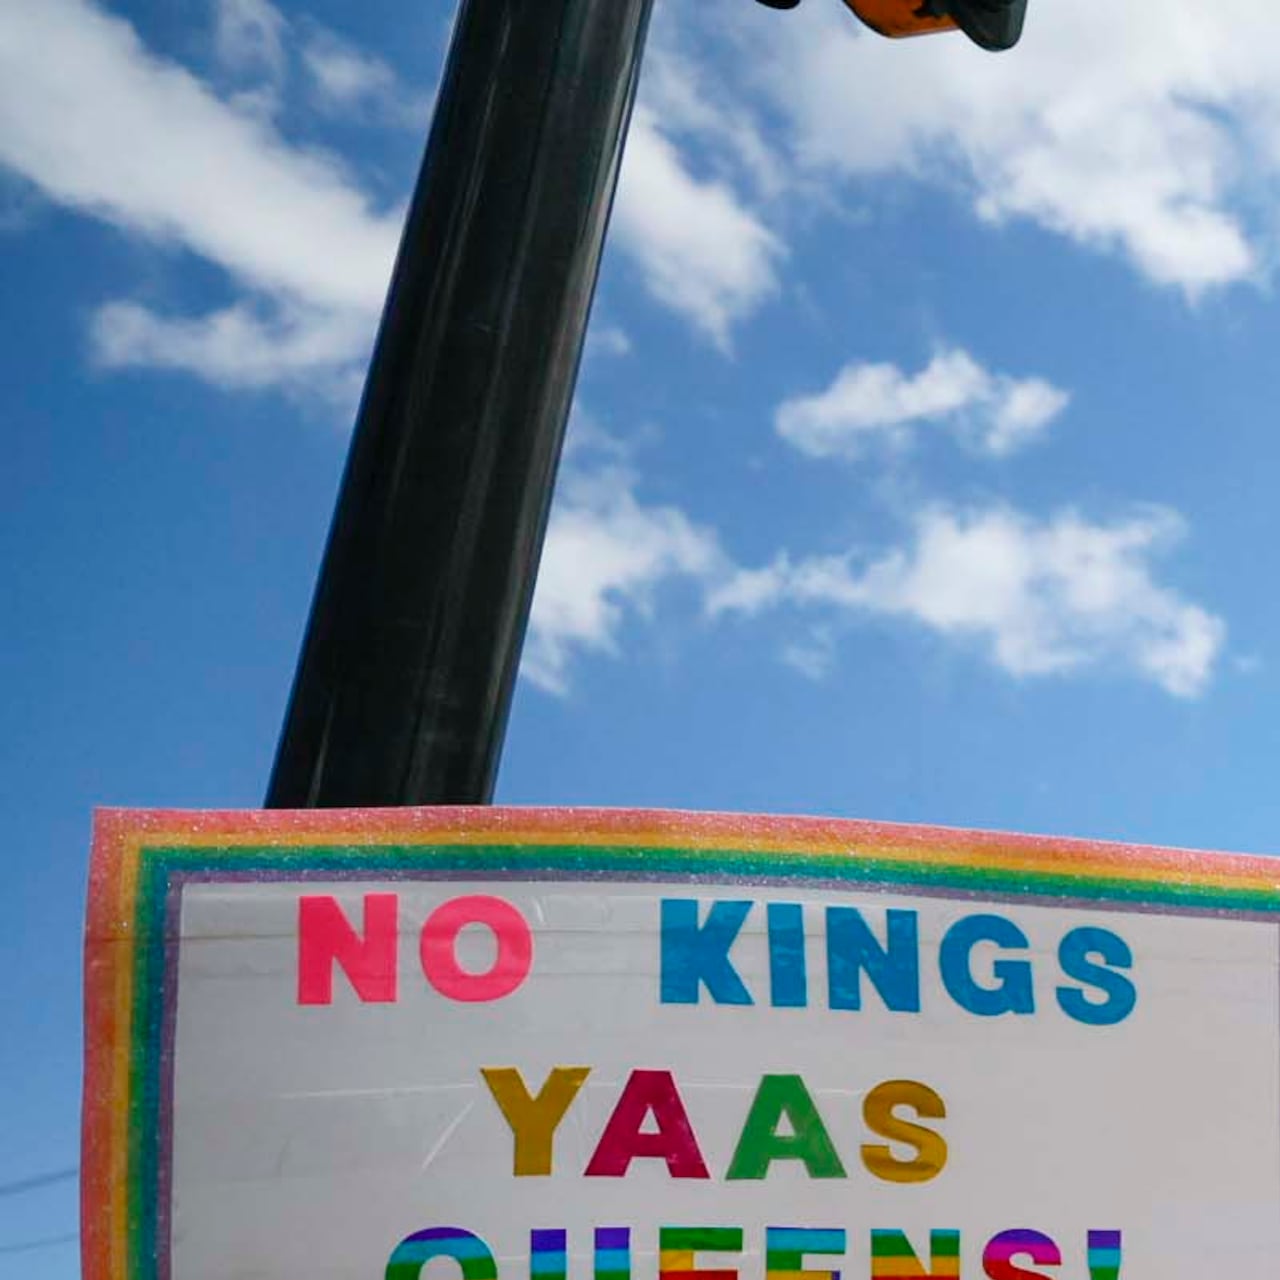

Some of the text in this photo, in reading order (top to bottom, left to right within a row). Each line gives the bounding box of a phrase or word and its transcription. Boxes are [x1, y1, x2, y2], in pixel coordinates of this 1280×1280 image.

[296, 892, 1137, 1026] NO KINGS
[481, 1066, 947, 1183] YAAS
